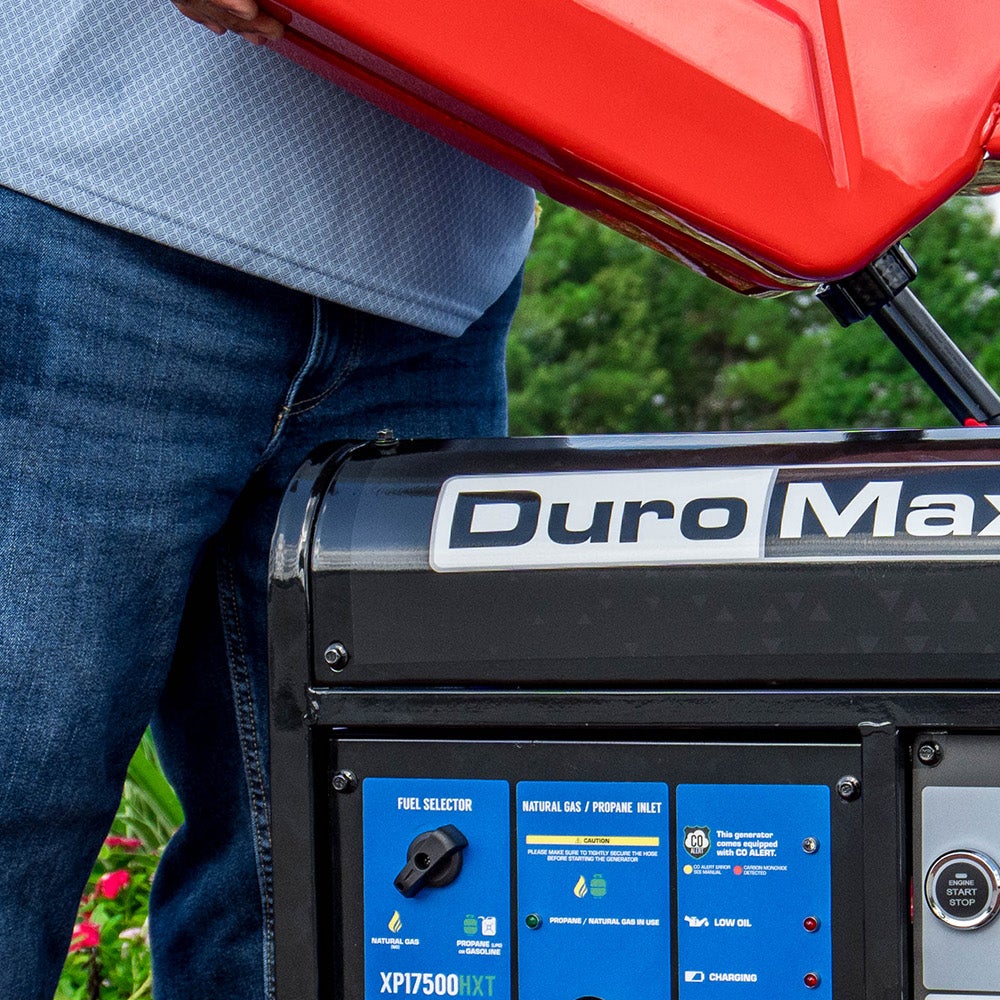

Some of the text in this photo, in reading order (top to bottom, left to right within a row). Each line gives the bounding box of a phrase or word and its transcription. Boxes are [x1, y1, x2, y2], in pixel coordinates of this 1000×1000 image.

[397, 797, 473, 812] FUEL SELECTOR
[522, 800, 662, 814] NATURAL GAS / PROPANE INLET
[716, 830, 774, 840] This generator
[690, 834, 704, 847] CO
[716, 840, 778, 849] comes equipped
[716, 848, 777, 857] with CO ALERT.
[948, 879, 975, 887] ENGINE
[946, 888, 977, 896] START
[949, 898, 976, 906] STOP
[621, 918, 636, 926] GAS
[714, 918, 752, 927] LOW OIL
[371, 937, 420, 946] NATURAL GAS
[466, 948, 501, 956] GASOLINE
[708, 973, 758, 982] CHARGING
[379, 971, 496, 997] XP17500HXT
